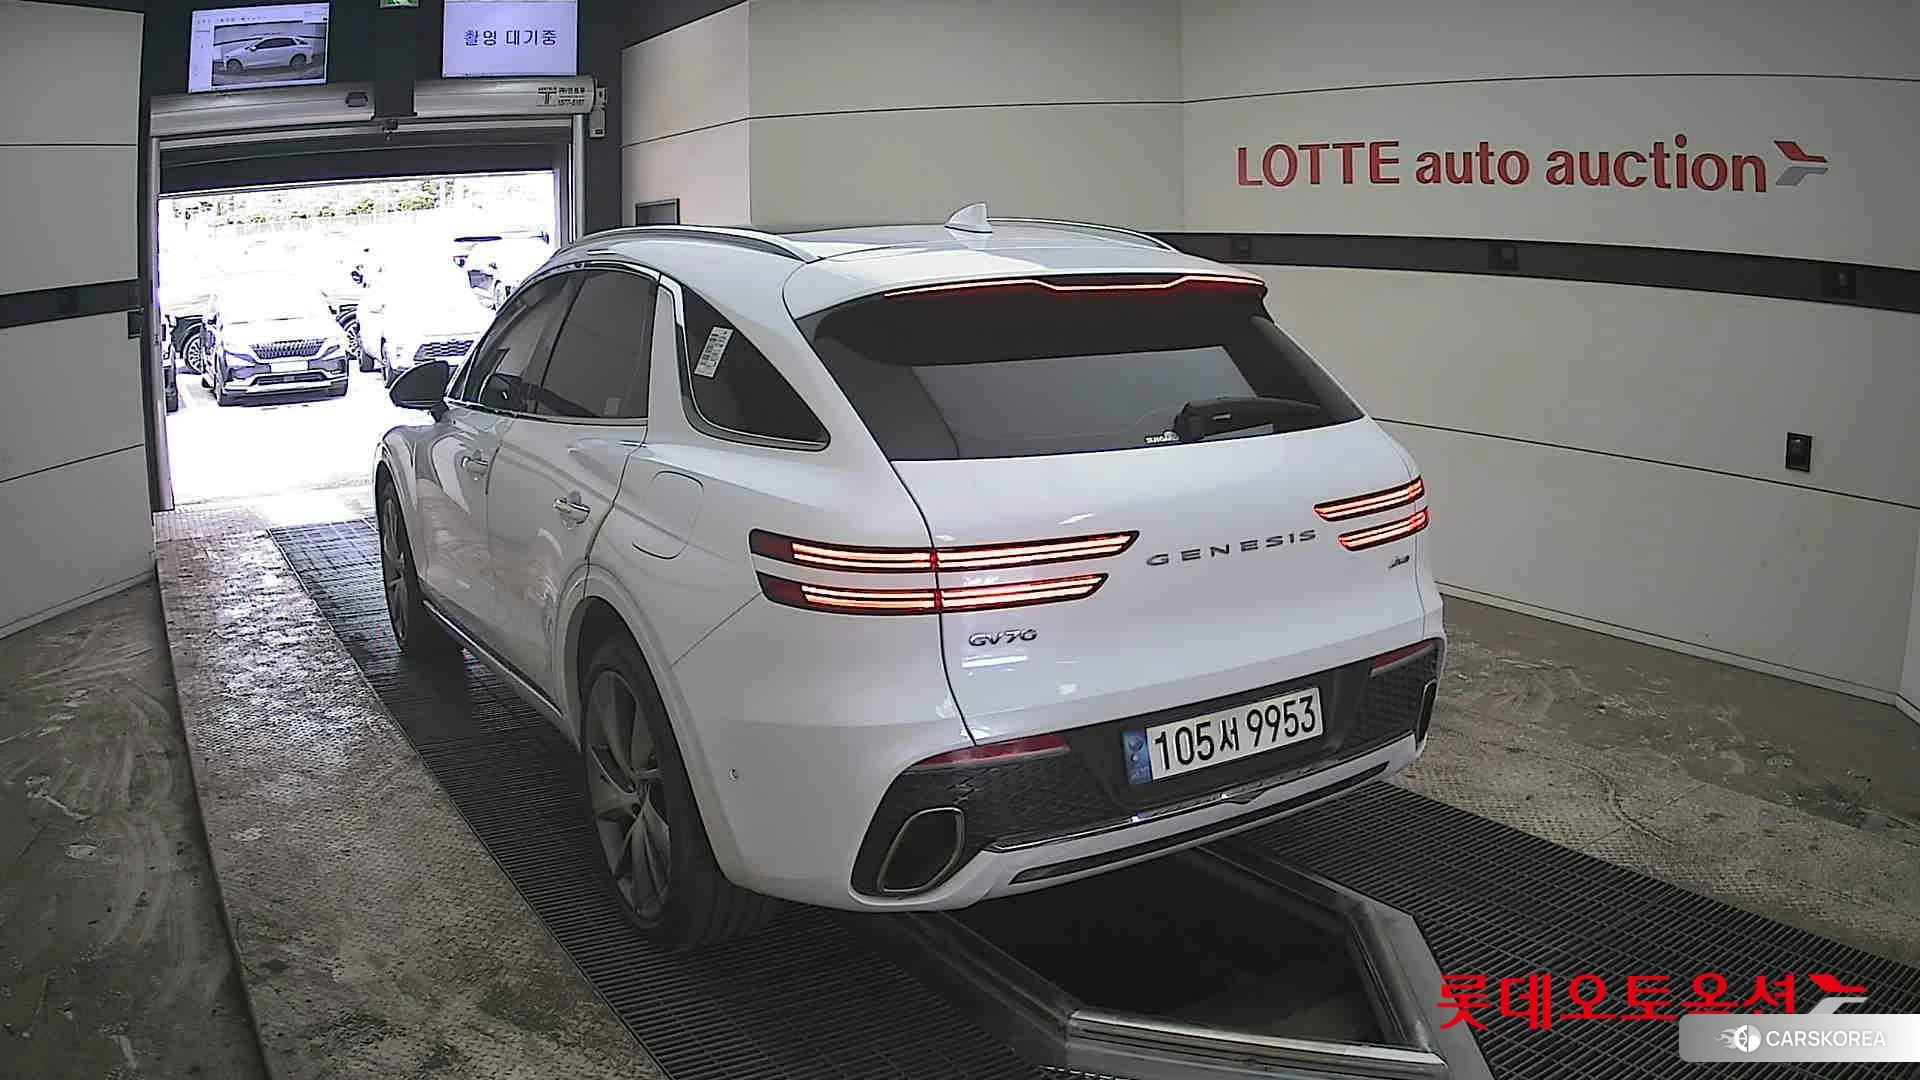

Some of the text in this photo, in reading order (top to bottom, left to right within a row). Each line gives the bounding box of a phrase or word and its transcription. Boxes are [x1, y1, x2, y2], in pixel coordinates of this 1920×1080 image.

[506, 30, 558, 46] 대기중
[1236, 133, 1768, 193] LOTTE auto auction
[1146, 529, 1317, 566] GENESIS
[968, 628, 1038, 647] GV70
[1154, 694, 1316, 770] 105서 9953
